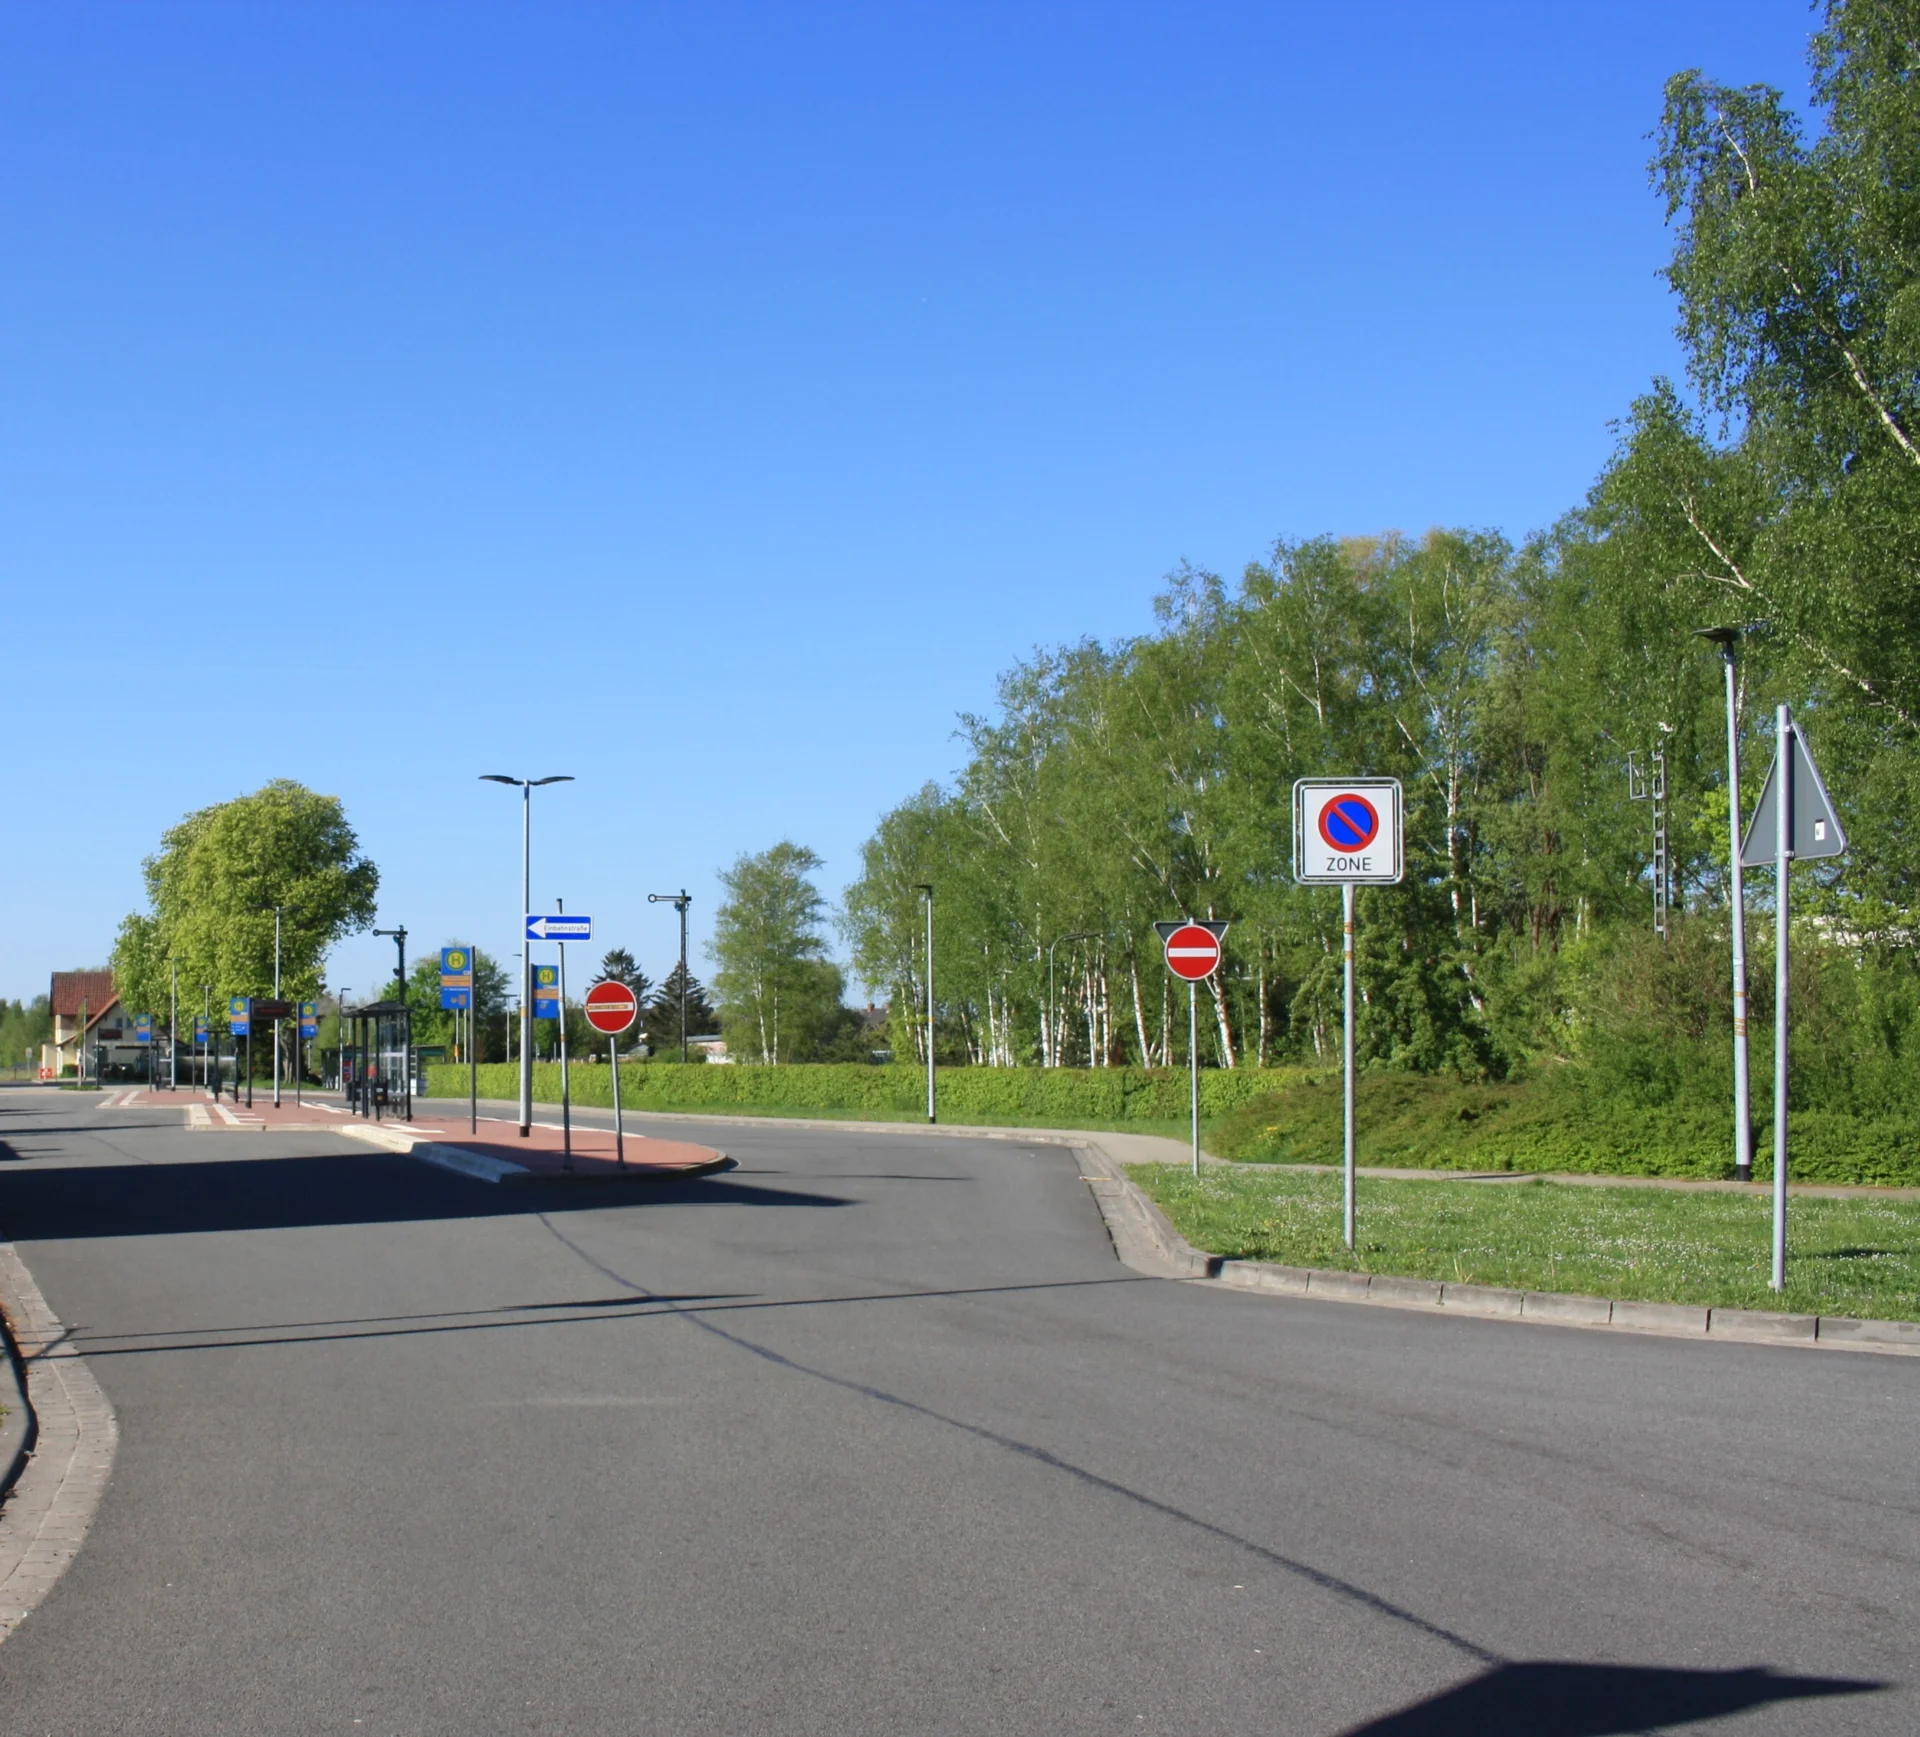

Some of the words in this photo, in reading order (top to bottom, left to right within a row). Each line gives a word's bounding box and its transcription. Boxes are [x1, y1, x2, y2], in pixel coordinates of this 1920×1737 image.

[1326, 857, 1372, 871] ZONE
[451, 955, 461, 965] H
[542, 971, 550, 981] H
